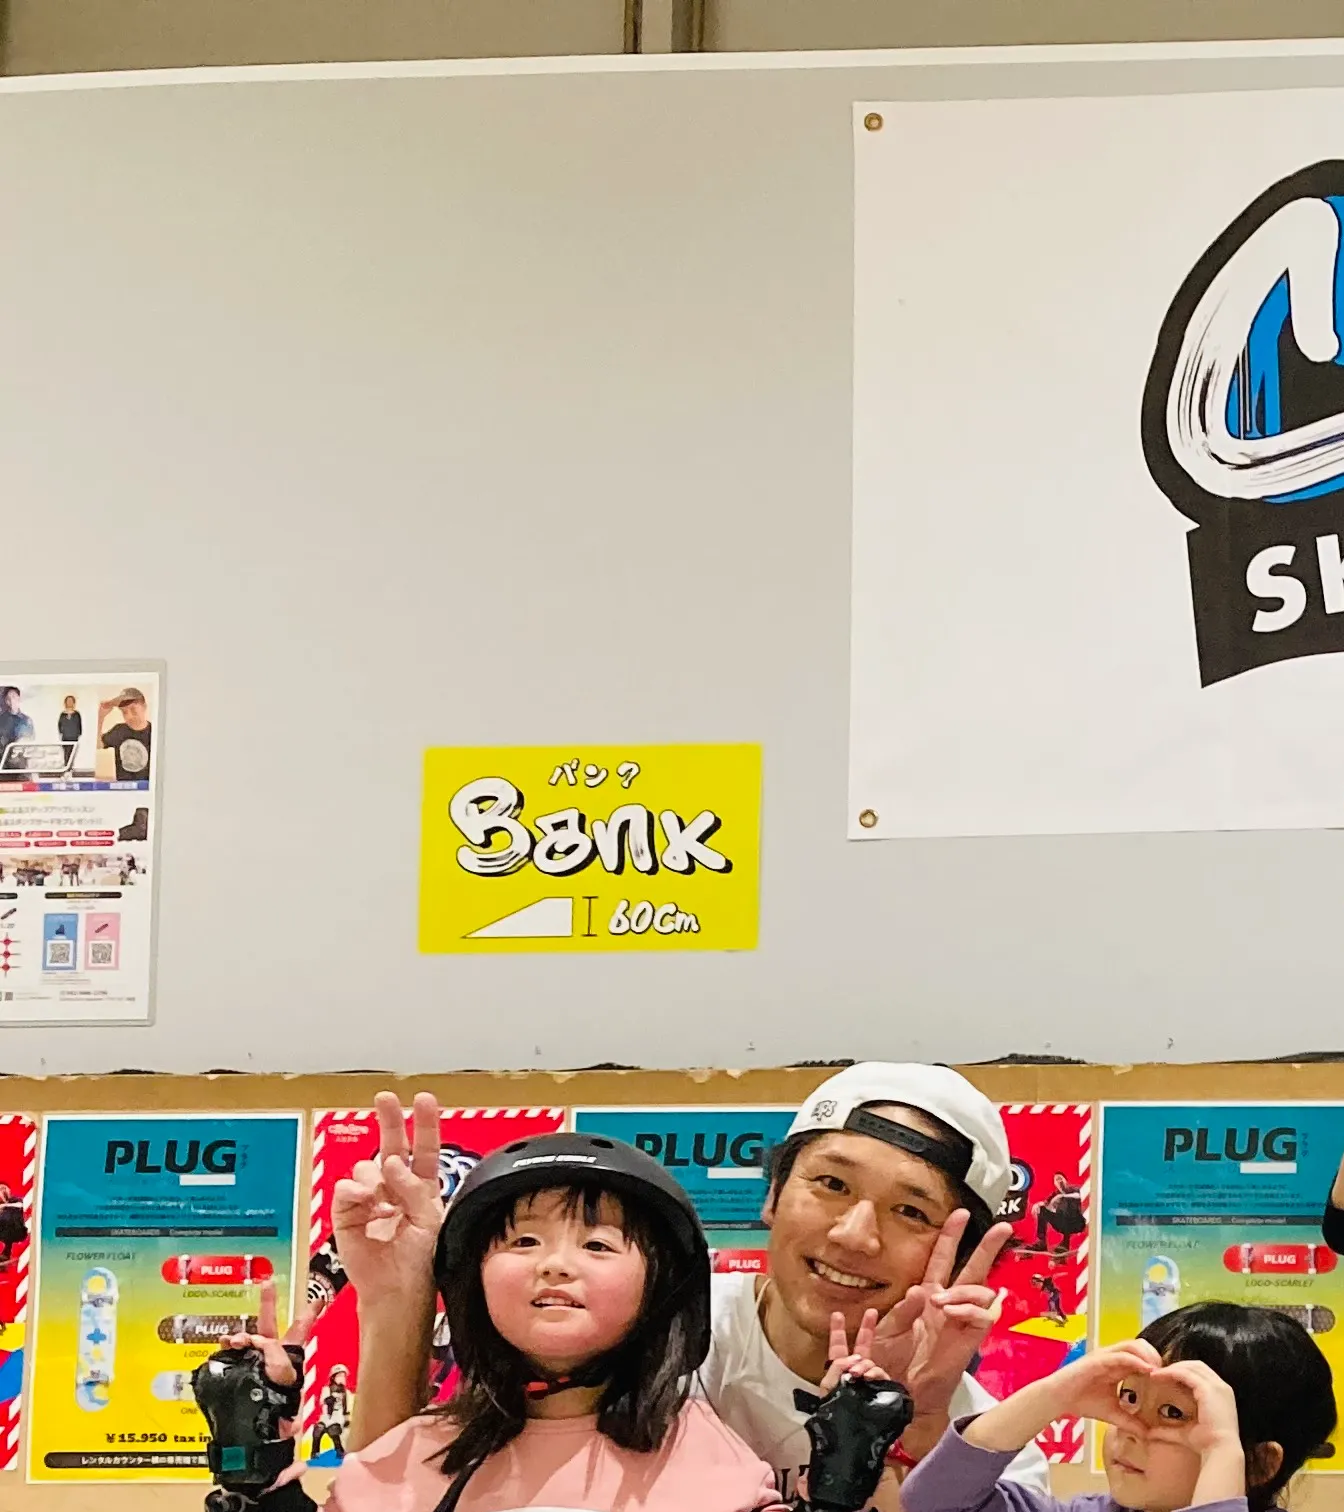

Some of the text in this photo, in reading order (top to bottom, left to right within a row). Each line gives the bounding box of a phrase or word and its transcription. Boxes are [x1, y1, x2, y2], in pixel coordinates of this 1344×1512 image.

[635, 1132, 764, 1167] PLUG
[1164, 1128, 1297, 1162] PLUG
[105, 1140, 236, 1174] PLUG
[66, 1252, 106, 1261] FLOWER
[1263, 1254, 1297, 1264] PLUG
[728, 1259, 761, 1269] PLUG
[201, 1265, 233, 1276] PLUG
[195, 1325, 230, 1336] PLUG
[174, 1434, 196, 1443] tax
